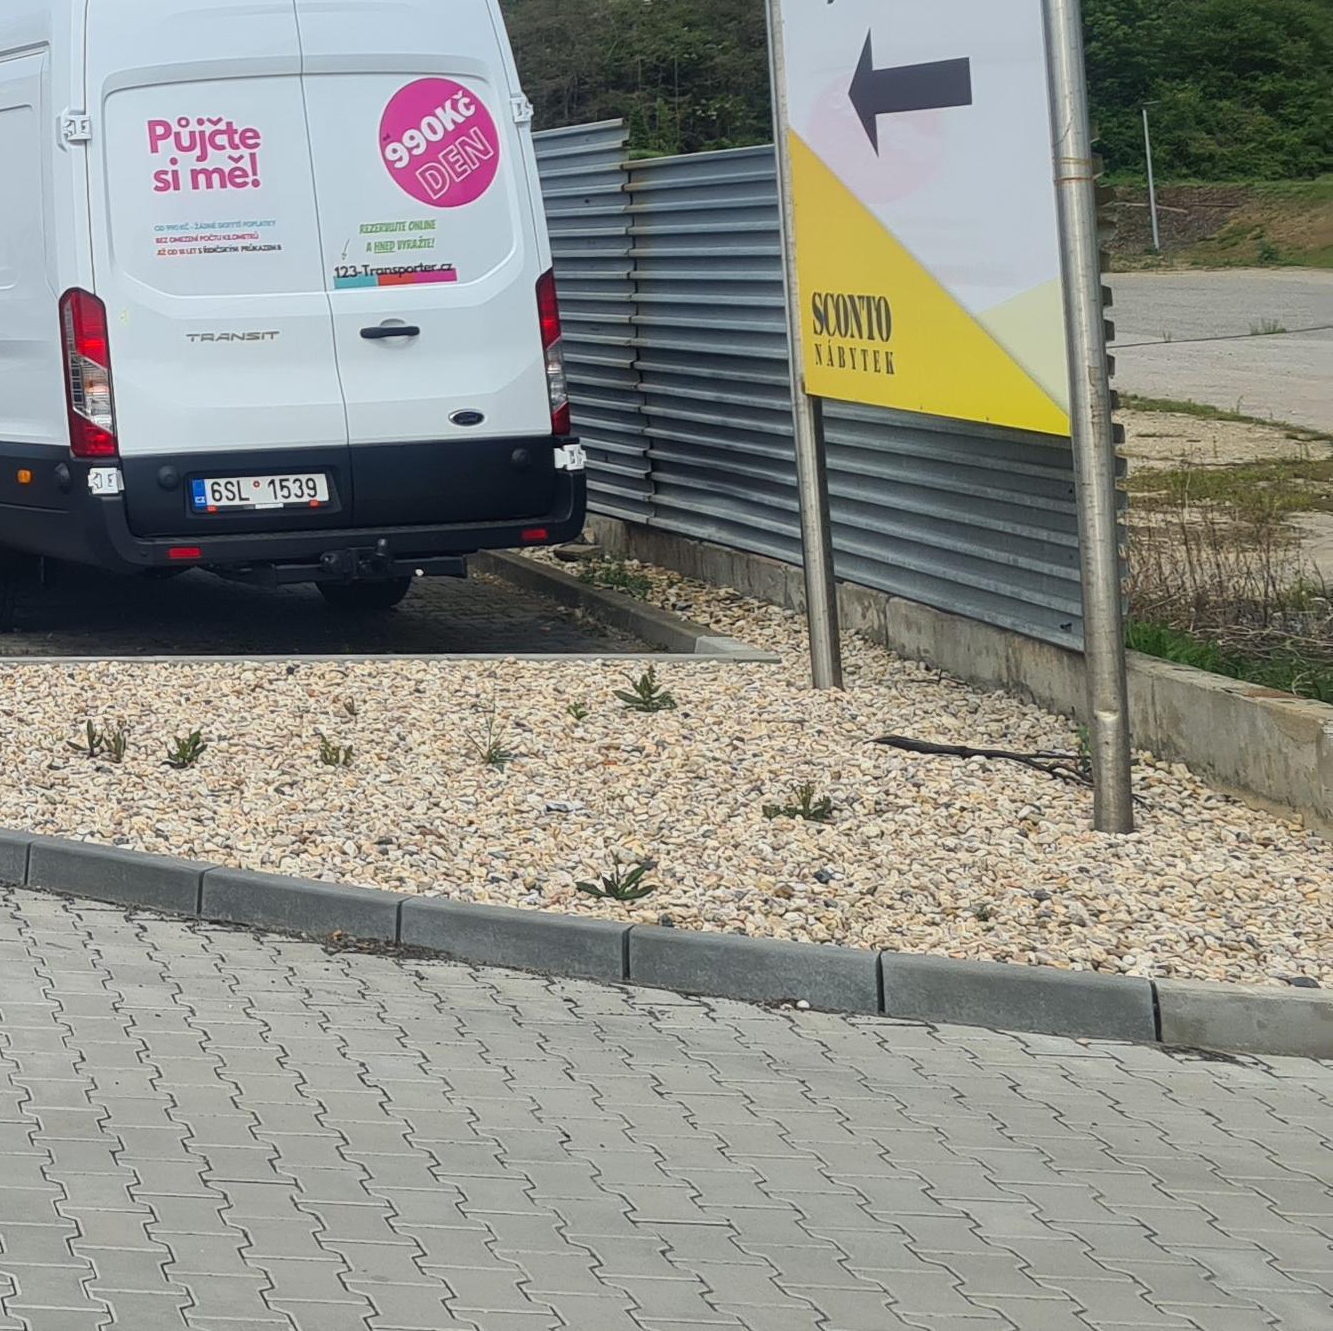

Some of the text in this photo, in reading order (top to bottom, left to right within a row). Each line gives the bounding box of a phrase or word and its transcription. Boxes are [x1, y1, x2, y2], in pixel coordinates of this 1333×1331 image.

[147, 116, 261, 162] Půjčte
[153, 152, 261, 191] si mě!
[415, 126, 494, 199] DEN
[334, 262, 453, 279] 123-Transporter.cz
[812, 291, 892, 342] SCONTO
[186, 330, 280, 342] TRANSIT
[814, 339, 895, 375] NÁBYTEK
[211, 477, 318, 502] 6SL 1539
